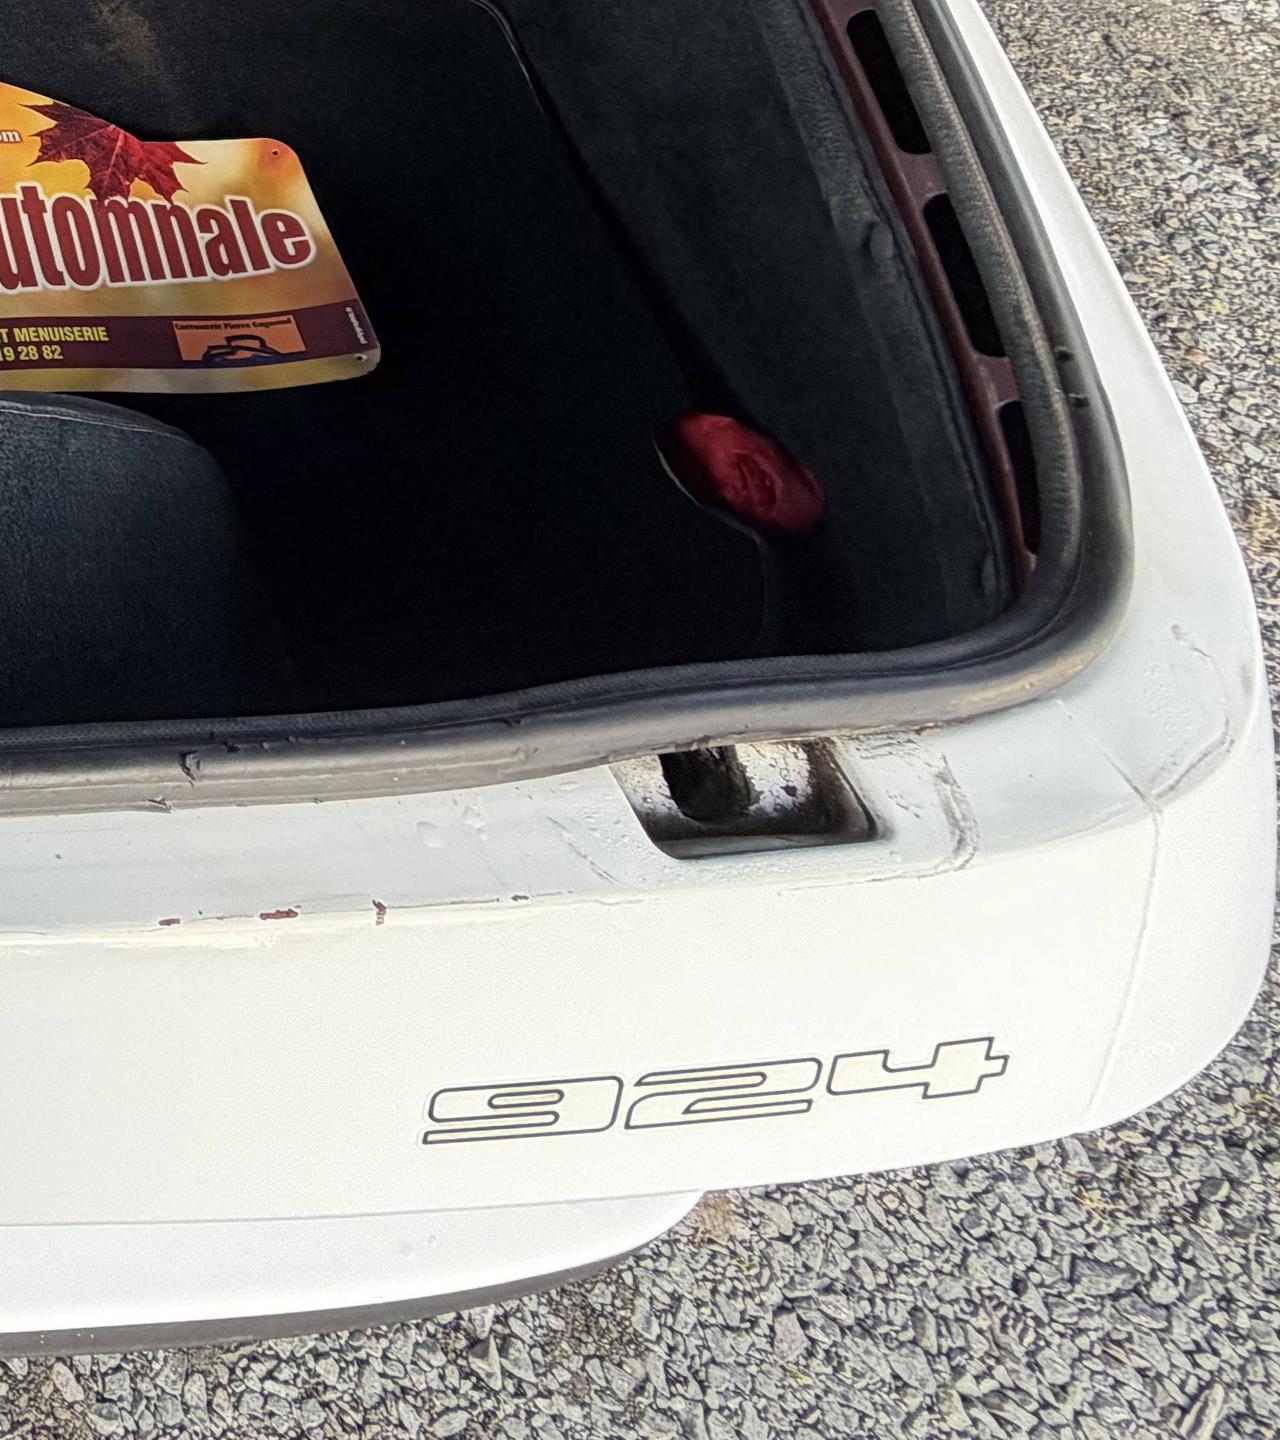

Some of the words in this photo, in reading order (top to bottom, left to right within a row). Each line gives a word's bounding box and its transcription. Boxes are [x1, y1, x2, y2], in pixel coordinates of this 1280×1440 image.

[13, 326, 109, 344] MENUISERIE
[18, 345, 38, 361] 28
[42, 344, 63, 360] 82
[422, 1036, 1010, 1145] 924
